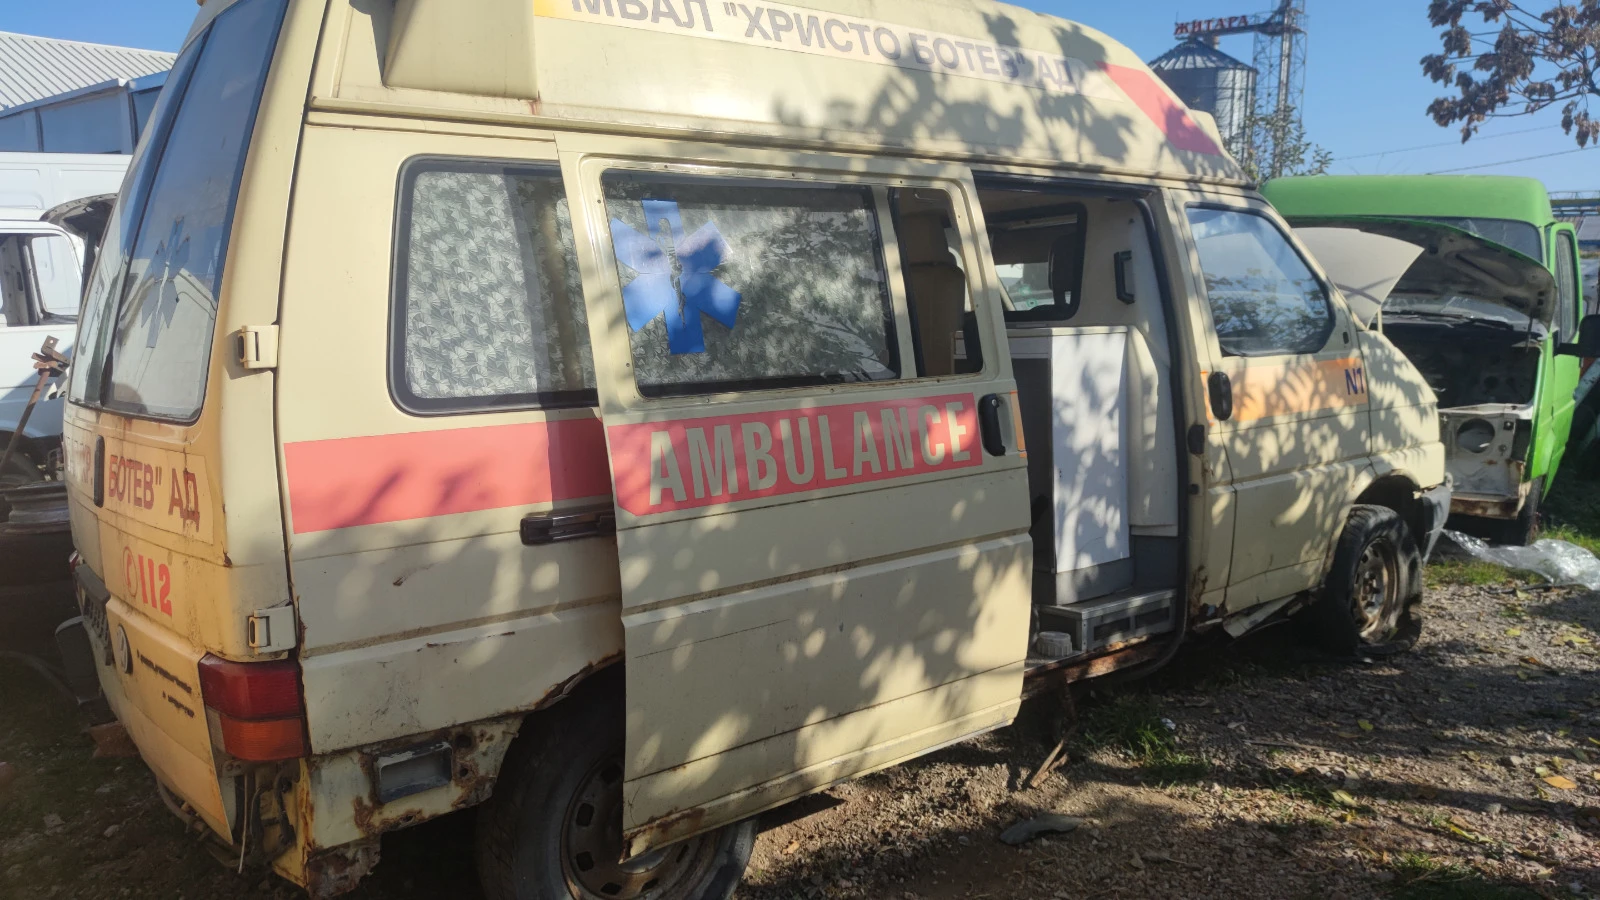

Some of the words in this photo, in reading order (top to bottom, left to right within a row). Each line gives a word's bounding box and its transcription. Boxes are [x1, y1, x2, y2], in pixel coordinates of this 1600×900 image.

[722, 2, 901, 60] "ХРИСТО
[908, 31, 1027, 79] БОТЕВ"
[1036, 54, 1081, 93] АД
[1344, 367, 1365, 396] N1
[108, 454, 163, 511] БОТЕВ"
[168, 466, 200, 532] АД
[648, 401, 971, 507] AMBULANCE
[138, 553, 173, 617] 112
